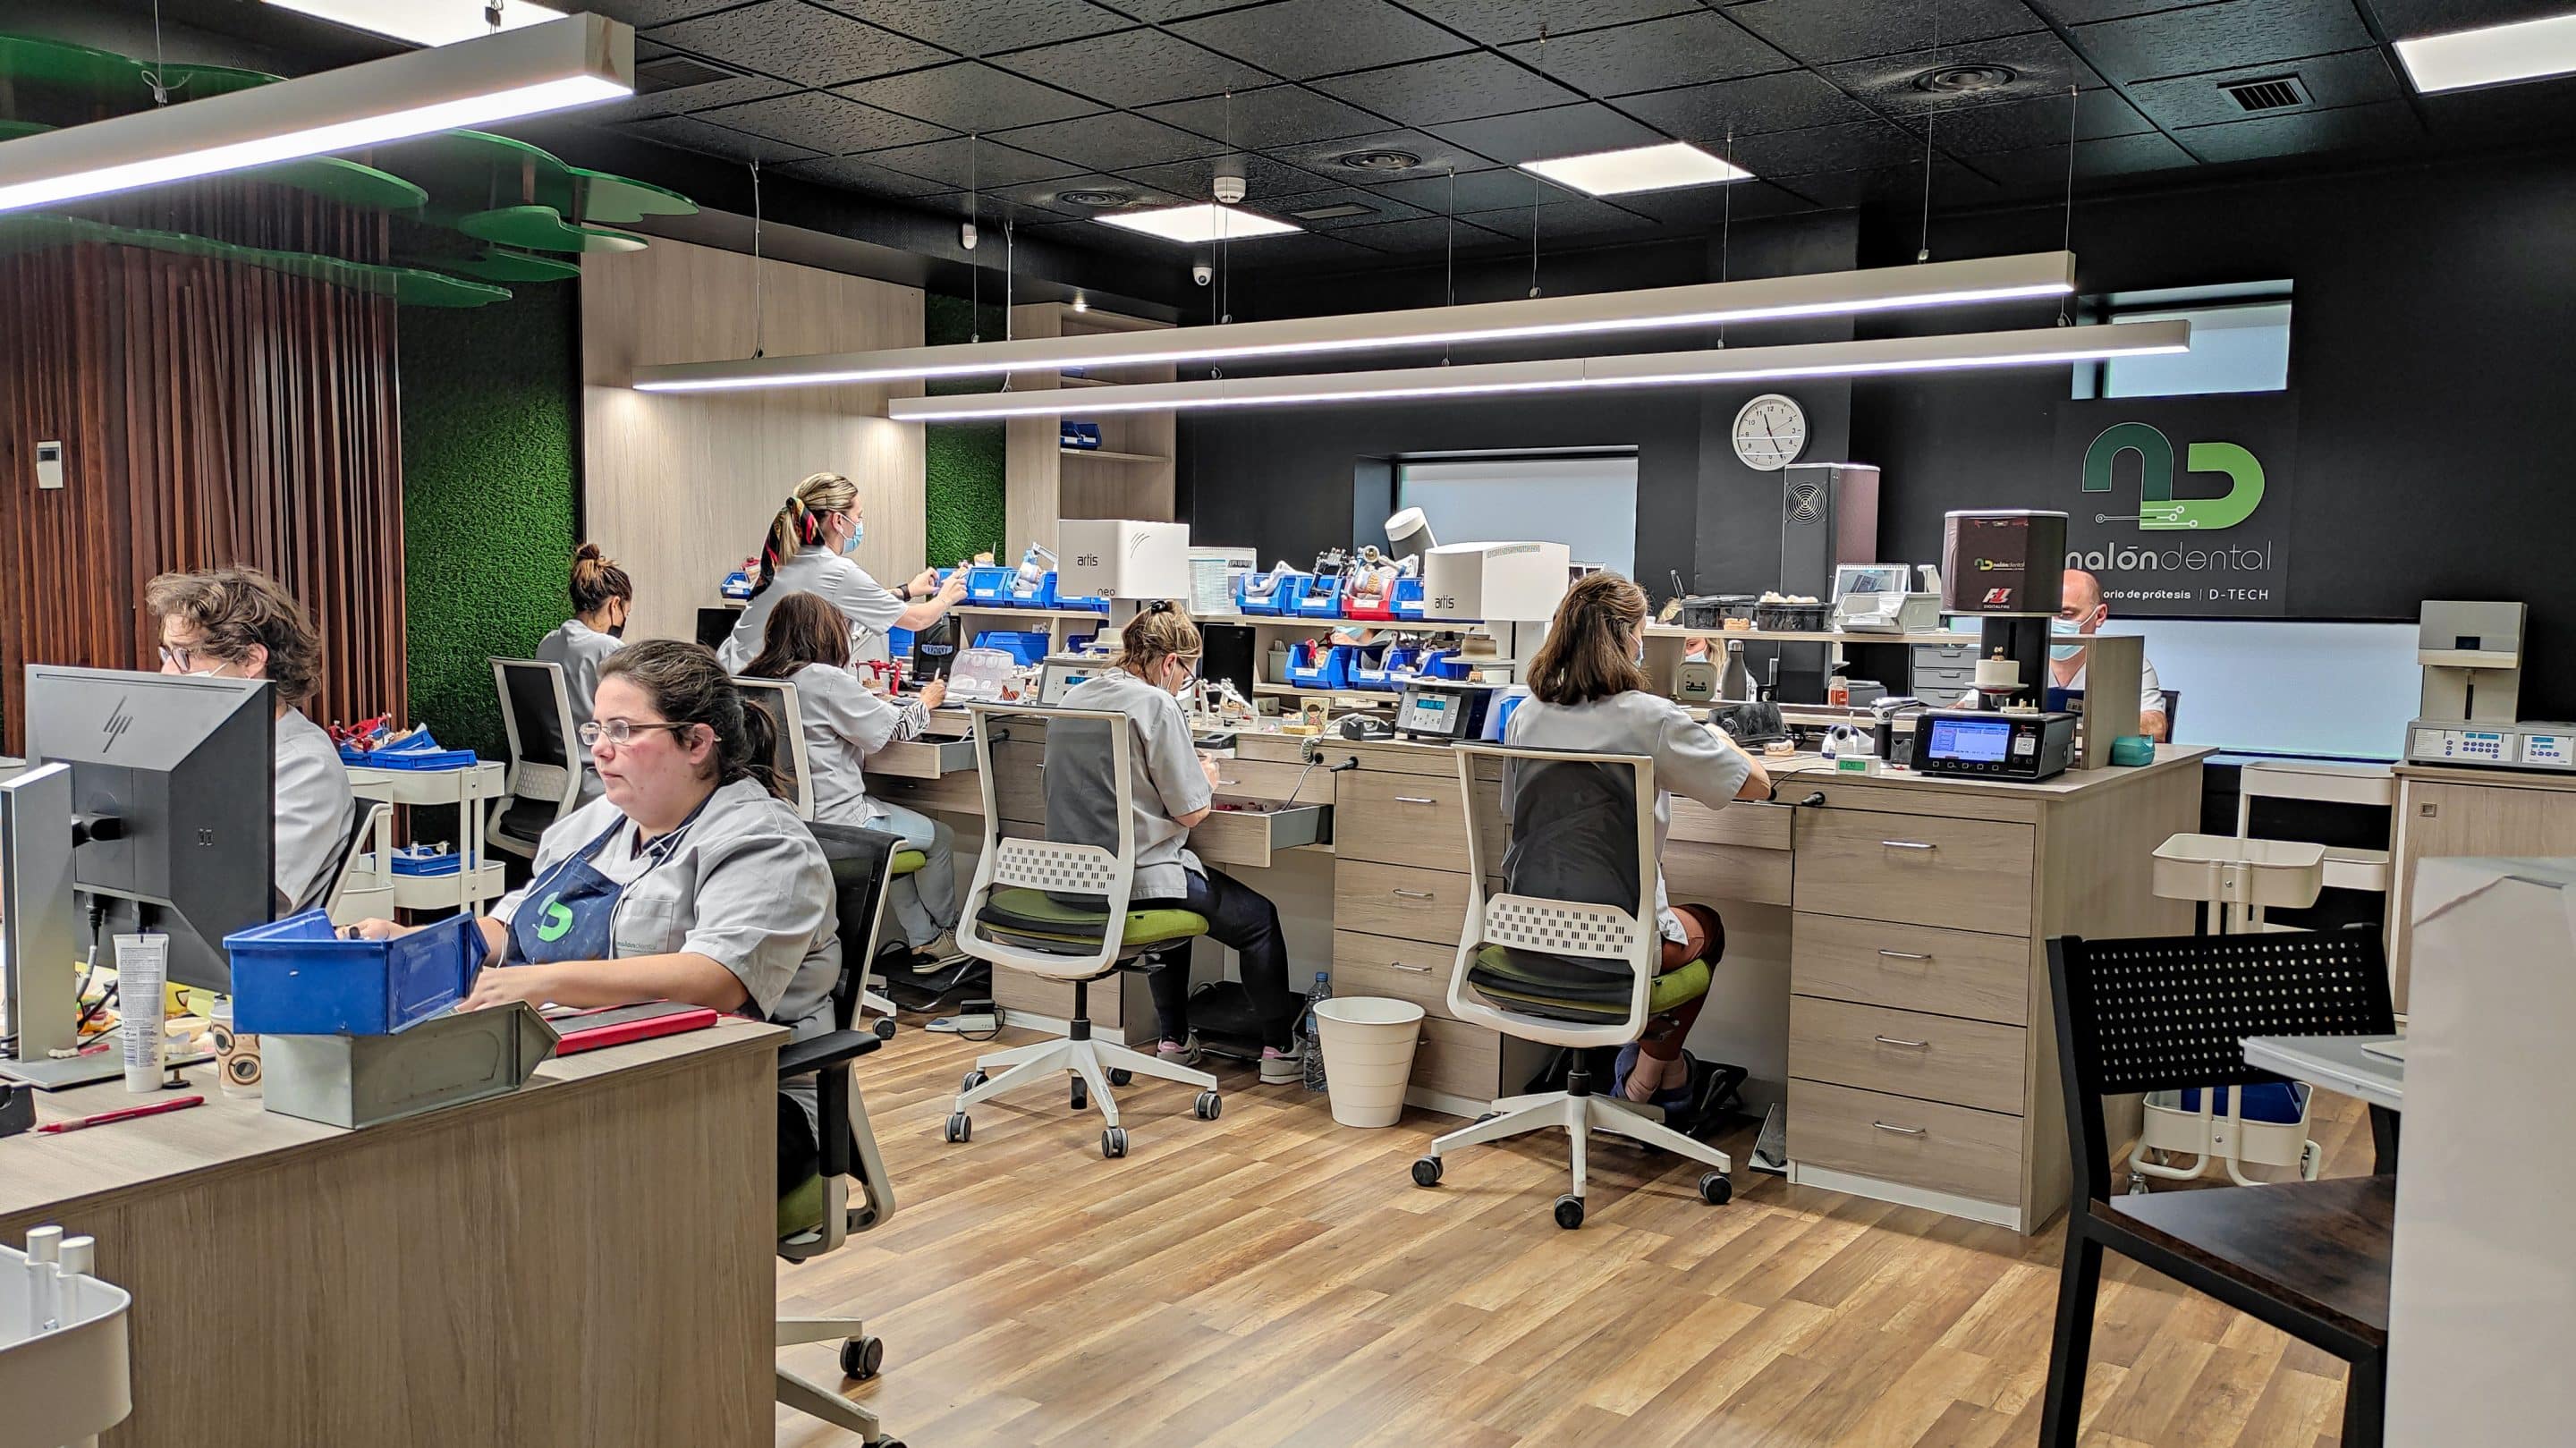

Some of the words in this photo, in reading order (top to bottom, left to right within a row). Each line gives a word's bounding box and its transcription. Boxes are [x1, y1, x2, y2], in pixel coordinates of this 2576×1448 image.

[1077, 553, 1098, 566] artis
[1097, 588, 1115, 597] neo
[2103, 590, 2125, 599] orio
[2126, 589, 2140, 599] de
[2208, 589, 2269, 601] D-TECH
[1434, 594, 1454, 609] artis
